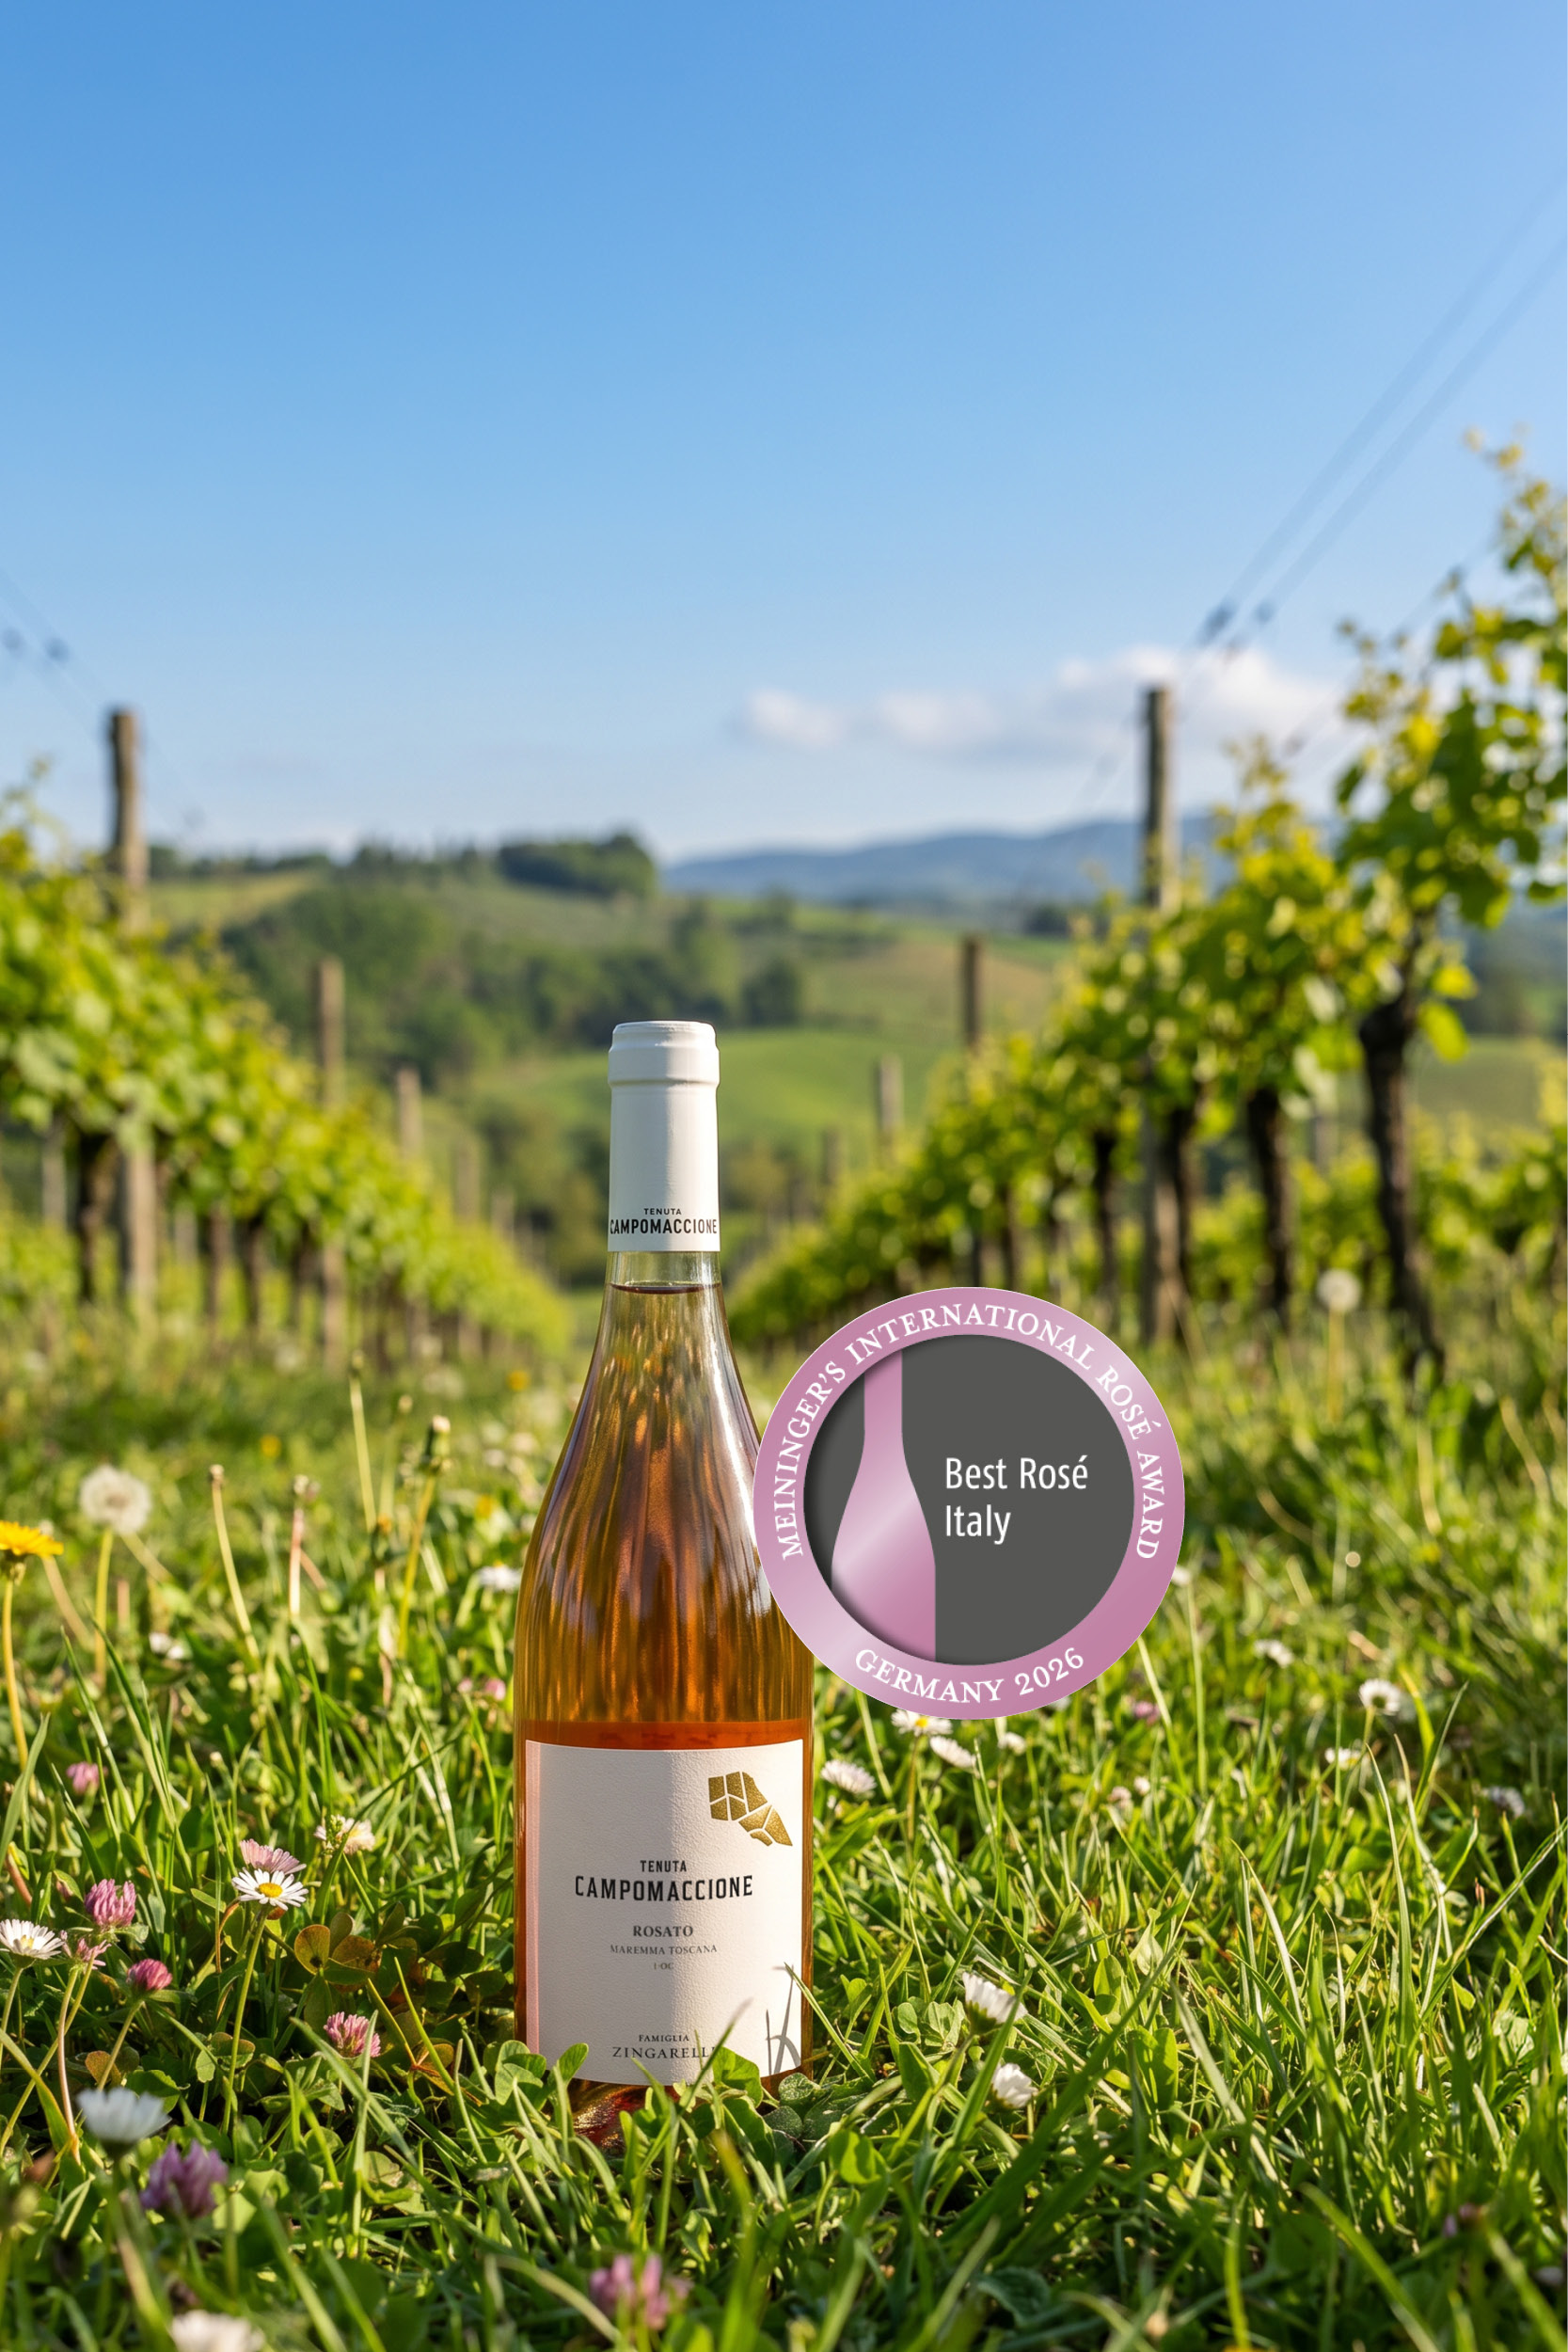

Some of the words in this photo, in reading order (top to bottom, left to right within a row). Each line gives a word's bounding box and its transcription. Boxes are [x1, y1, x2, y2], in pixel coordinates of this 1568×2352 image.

[610, 1218, 717, 1234] CAMPOMACCIONE
[640, 1860, 687, 1872] TENUTA
[575, 1875, 752, 1901] CAMPOMACCIONE
[633, 1925, 693, 1937] ROSATO
[610, 1944, 665, 1955] MAREMMA
[669, 1944, 717, 1955] TOSCANA
[639, 2034, 689, 2042] FAMIGLIA
